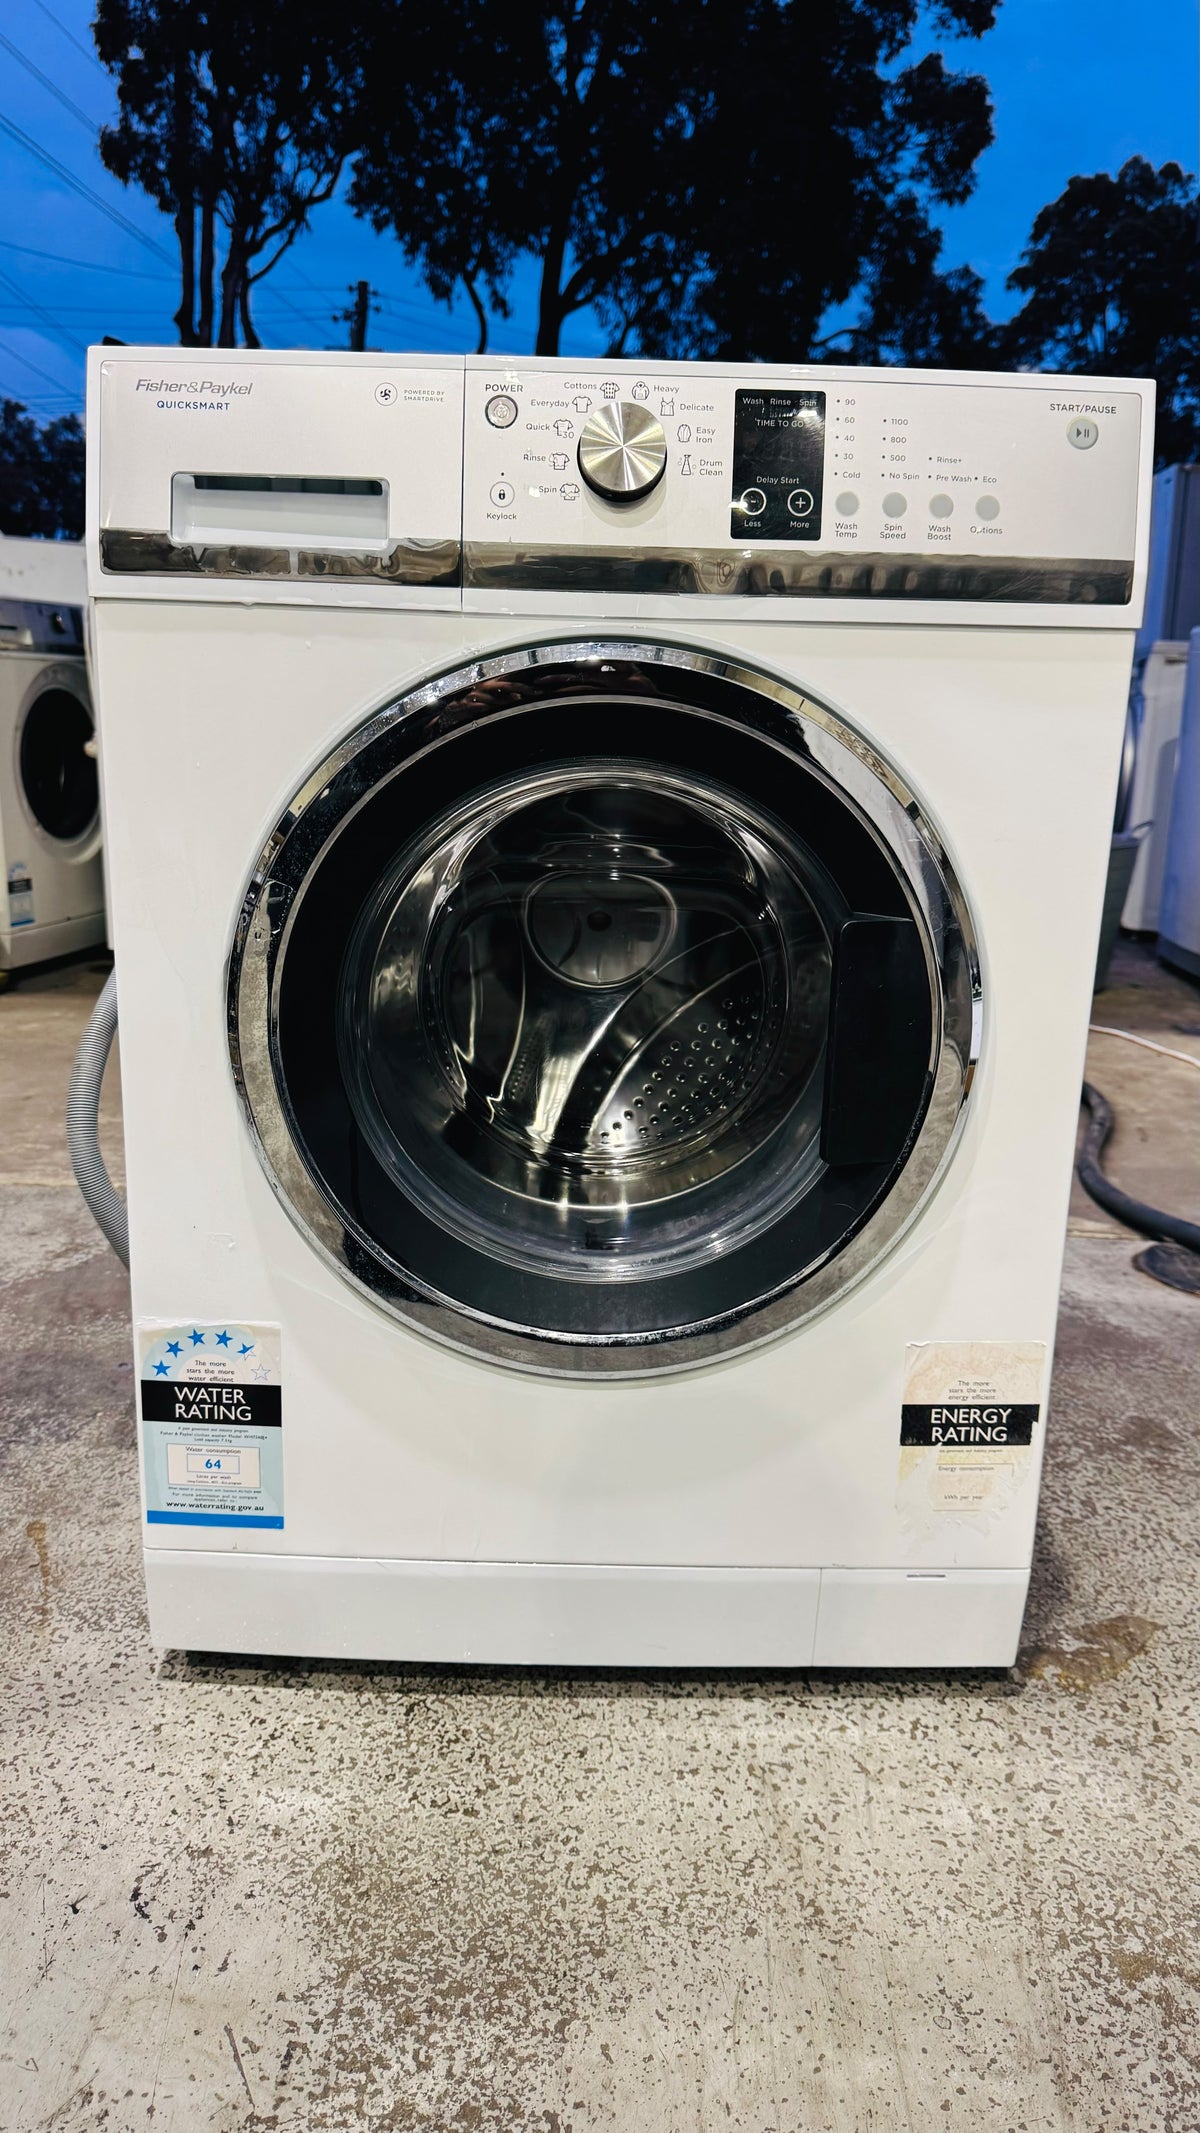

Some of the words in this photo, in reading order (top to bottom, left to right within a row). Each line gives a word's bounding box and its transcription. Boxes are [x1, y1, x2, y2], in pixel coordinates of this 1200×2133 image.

[136, 379, 253, 397] Fisher&Paykel
[485, 384, 524, 393] POWER
[564, 382, 597, 390] Cottons
[654, 384, 680, 394] Heavy
[157, 400, 230, 410] QUICKSMART
[530, 399, 570, 409] Everyday
[742, 397, 764, 405] Wash
[770, 398, 791, 406] Rinse
[799, 399, 817, 407] Spin
[680, 403, 715, 412] Delicate
[1050, 403, 1117, 414] START/PAUSE
[791, 420, 804, 428] GO
[891, 418, 909, 426] 1100
[526, 423, 551, 432] Quick
[696, 427, 716, 437] Easy
[562, 431, 575, 439] 30
[696, 435, 713, 444] Iron
[890, 436, 907, 444] 800
[523, 453, 546, 462] Rinse
[890, 454, 906, 462] 500
[936, 456, 962, 464] Rinse+
[700, 459, 723, 467] Drum
[699, 468, 723, 476] Clean
[902, 472, 920, 480] Spin
[756, 476, 778, 485] Delay
[950, 475, 972, 483] Wash
[538, 485, 557, 495] Spin
[486, 512, 517, 522] Keylock
[744, 520, 762, 528] Less
[790, 521, 810, 529] More
[835, 522, 858, 530] Wash
[884, 523, 903, 533] Spin
[928, 525, 951, 533] Wash
[835, 531, 857, 539] Temp
[879, 532, 906, 540] Speed
[174, 1386, 246, 1404] WATER
[175, 1404, 252, 1421] RATING
[930, 1408, 1012, 1424] ENERGY
[931, 1426, 1008, 1442] RATING
[205, 1459, 222, 1469] 64
[166, 1501, 264, 1512] www.waterrating.gov.au
